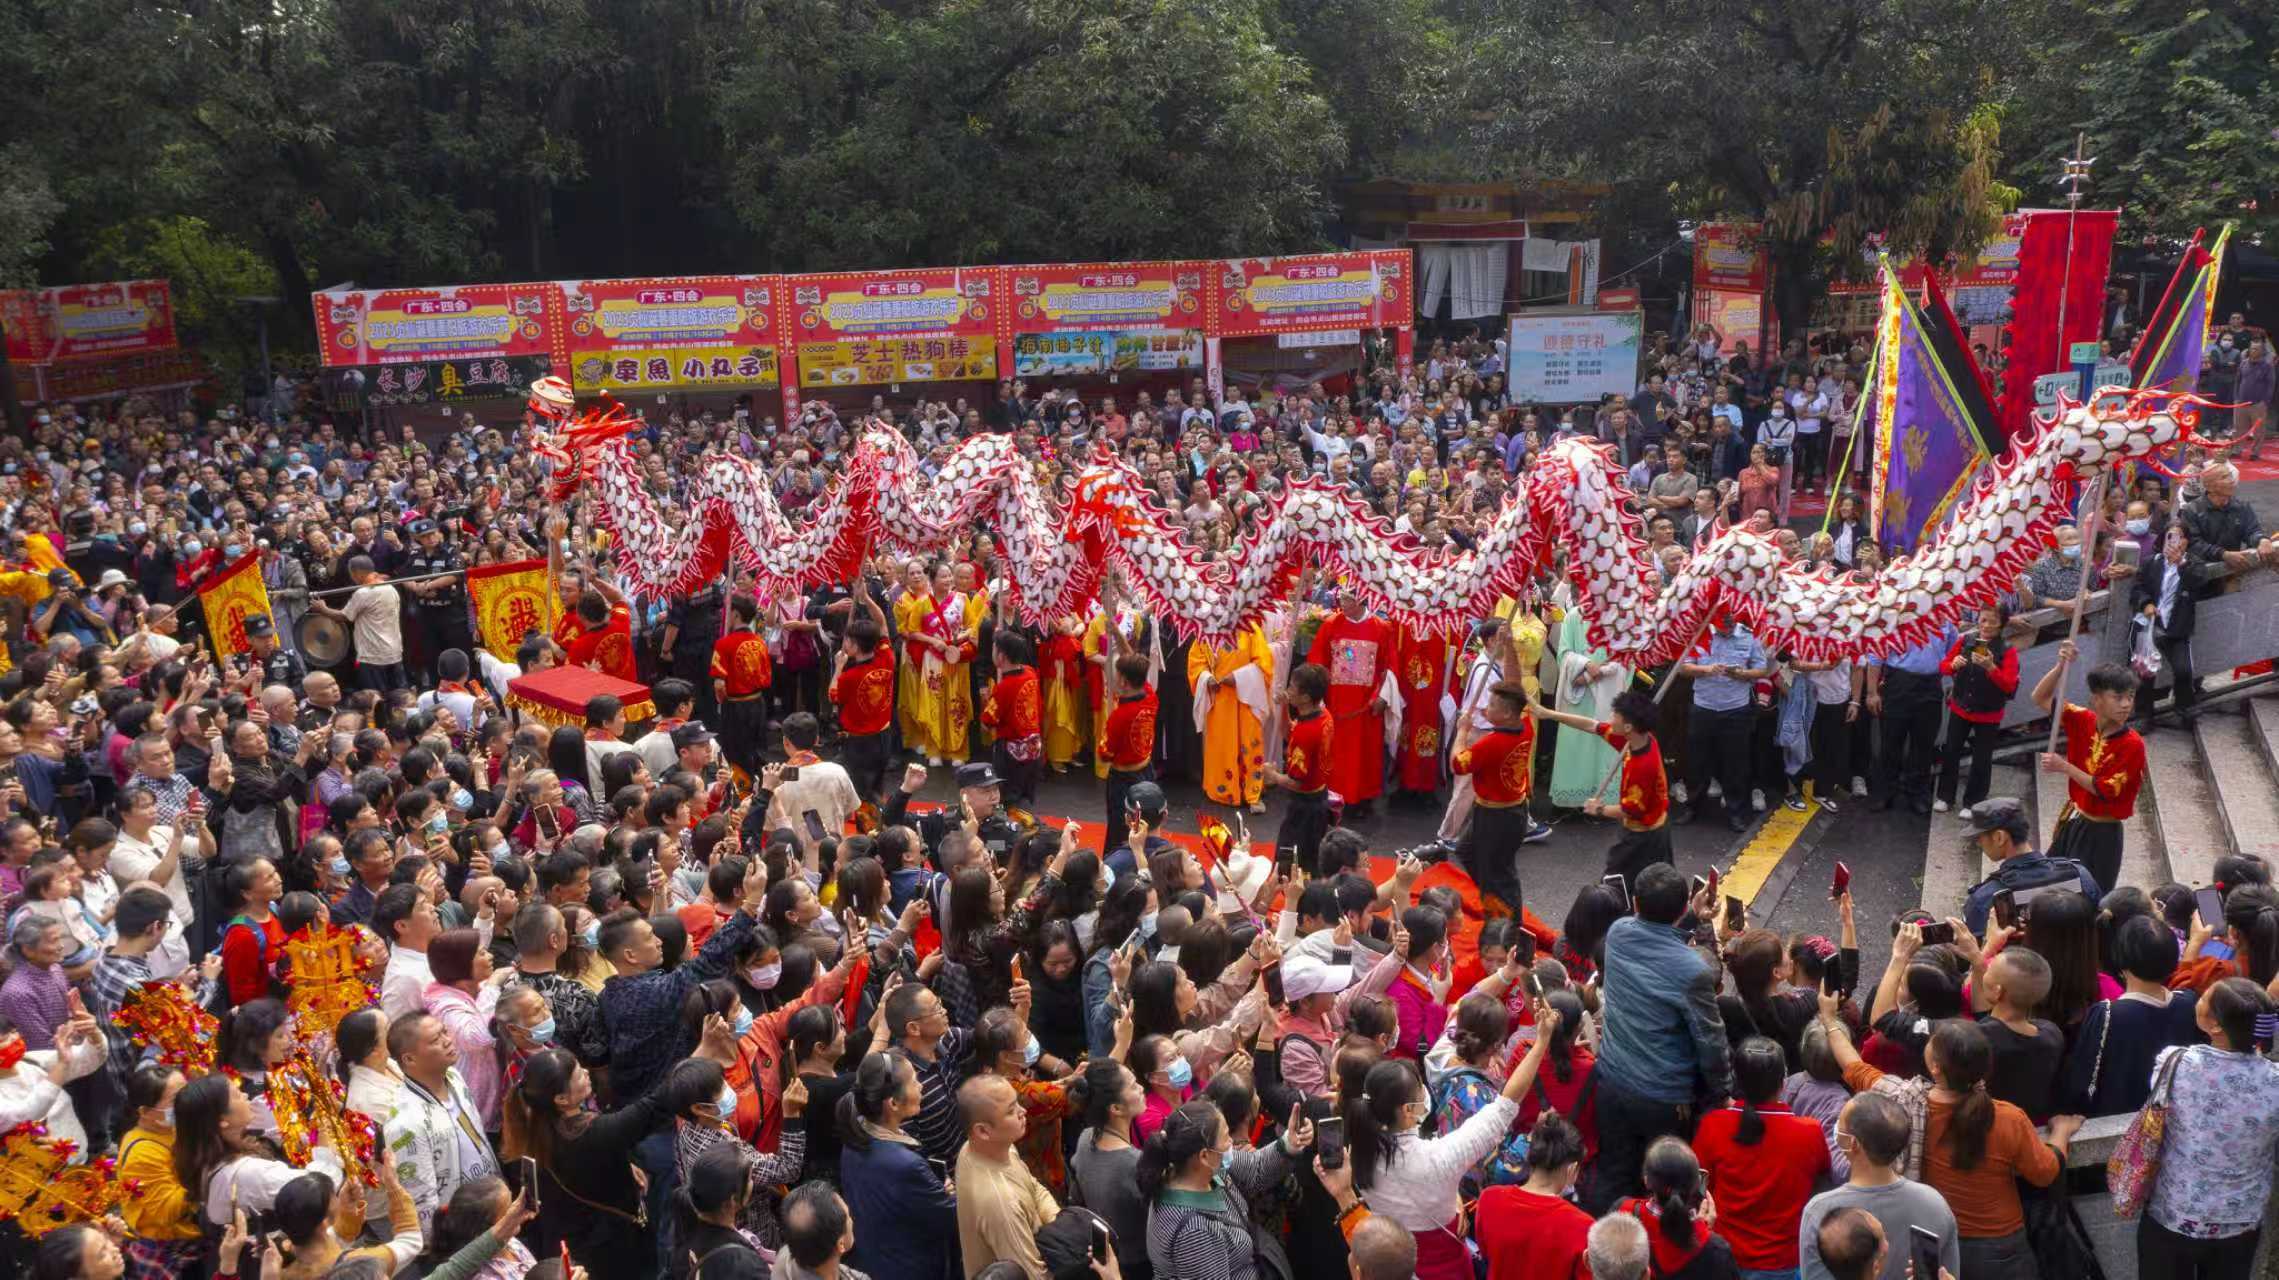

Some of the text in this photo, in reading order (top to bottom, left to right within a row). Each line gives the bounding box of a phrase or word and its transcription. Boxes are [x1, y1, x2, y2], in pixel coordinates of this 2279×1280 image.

[1287, 266, 1339, 279] 广东·四会
[1082, 274, 1136, 287] 广东·四会
[865, 283, 922, 295] 广东·四会
[640, 290, 699, 302] 广东·四会
[407, 301, 468, 313] 广东·四会
[851, 339, 969, 364] 芝士热狗棒
[375, 360, 512, 396] 长沙臭豆腐
